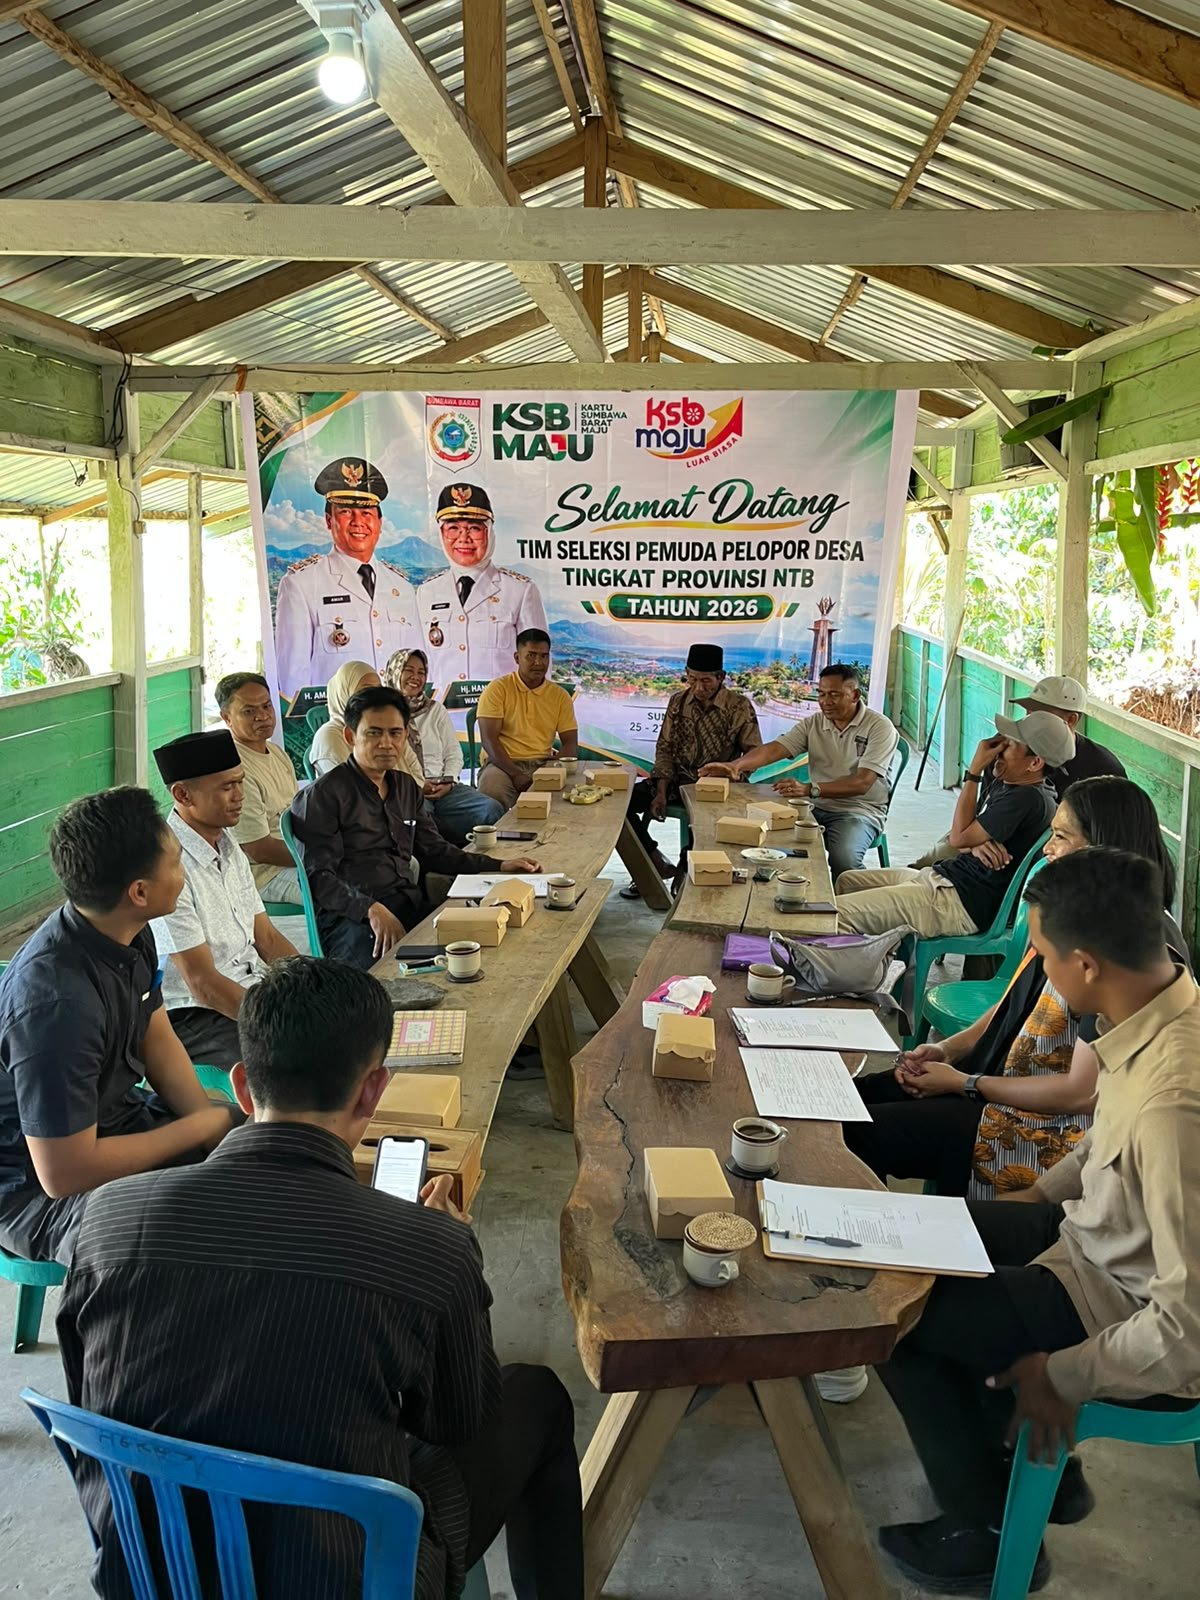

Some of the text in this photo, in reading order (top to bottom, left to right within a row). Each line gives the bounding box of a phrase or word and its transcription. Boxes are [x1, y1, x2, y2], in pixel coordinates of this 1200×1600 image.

[493, 402, 571, 432] KSB
[581, 411, 628, 419] SUMBAWA
[581, 419, 613, 427] BARAT
[493, 434, 594, 462] MAJU
[635, 423, 706, 454] maju
[686, 437, 738, 469] LUAR BIASA
[544, 478, 850, 534] Selamat Datang
[516, 539, 865, 562] TIM SELEKSI PEMUDA PELOPOR DESA
[562, 567, 815, 589] TINGKAT PROVINSI NTB
[627, 598, 759, 617] TAHUN 2026
[314, 691, 328, 699] AM
[460, 685, 470, 694] Hj.
[629, 722, 642, 732] 25
[652, 724, 663, 733] 2
